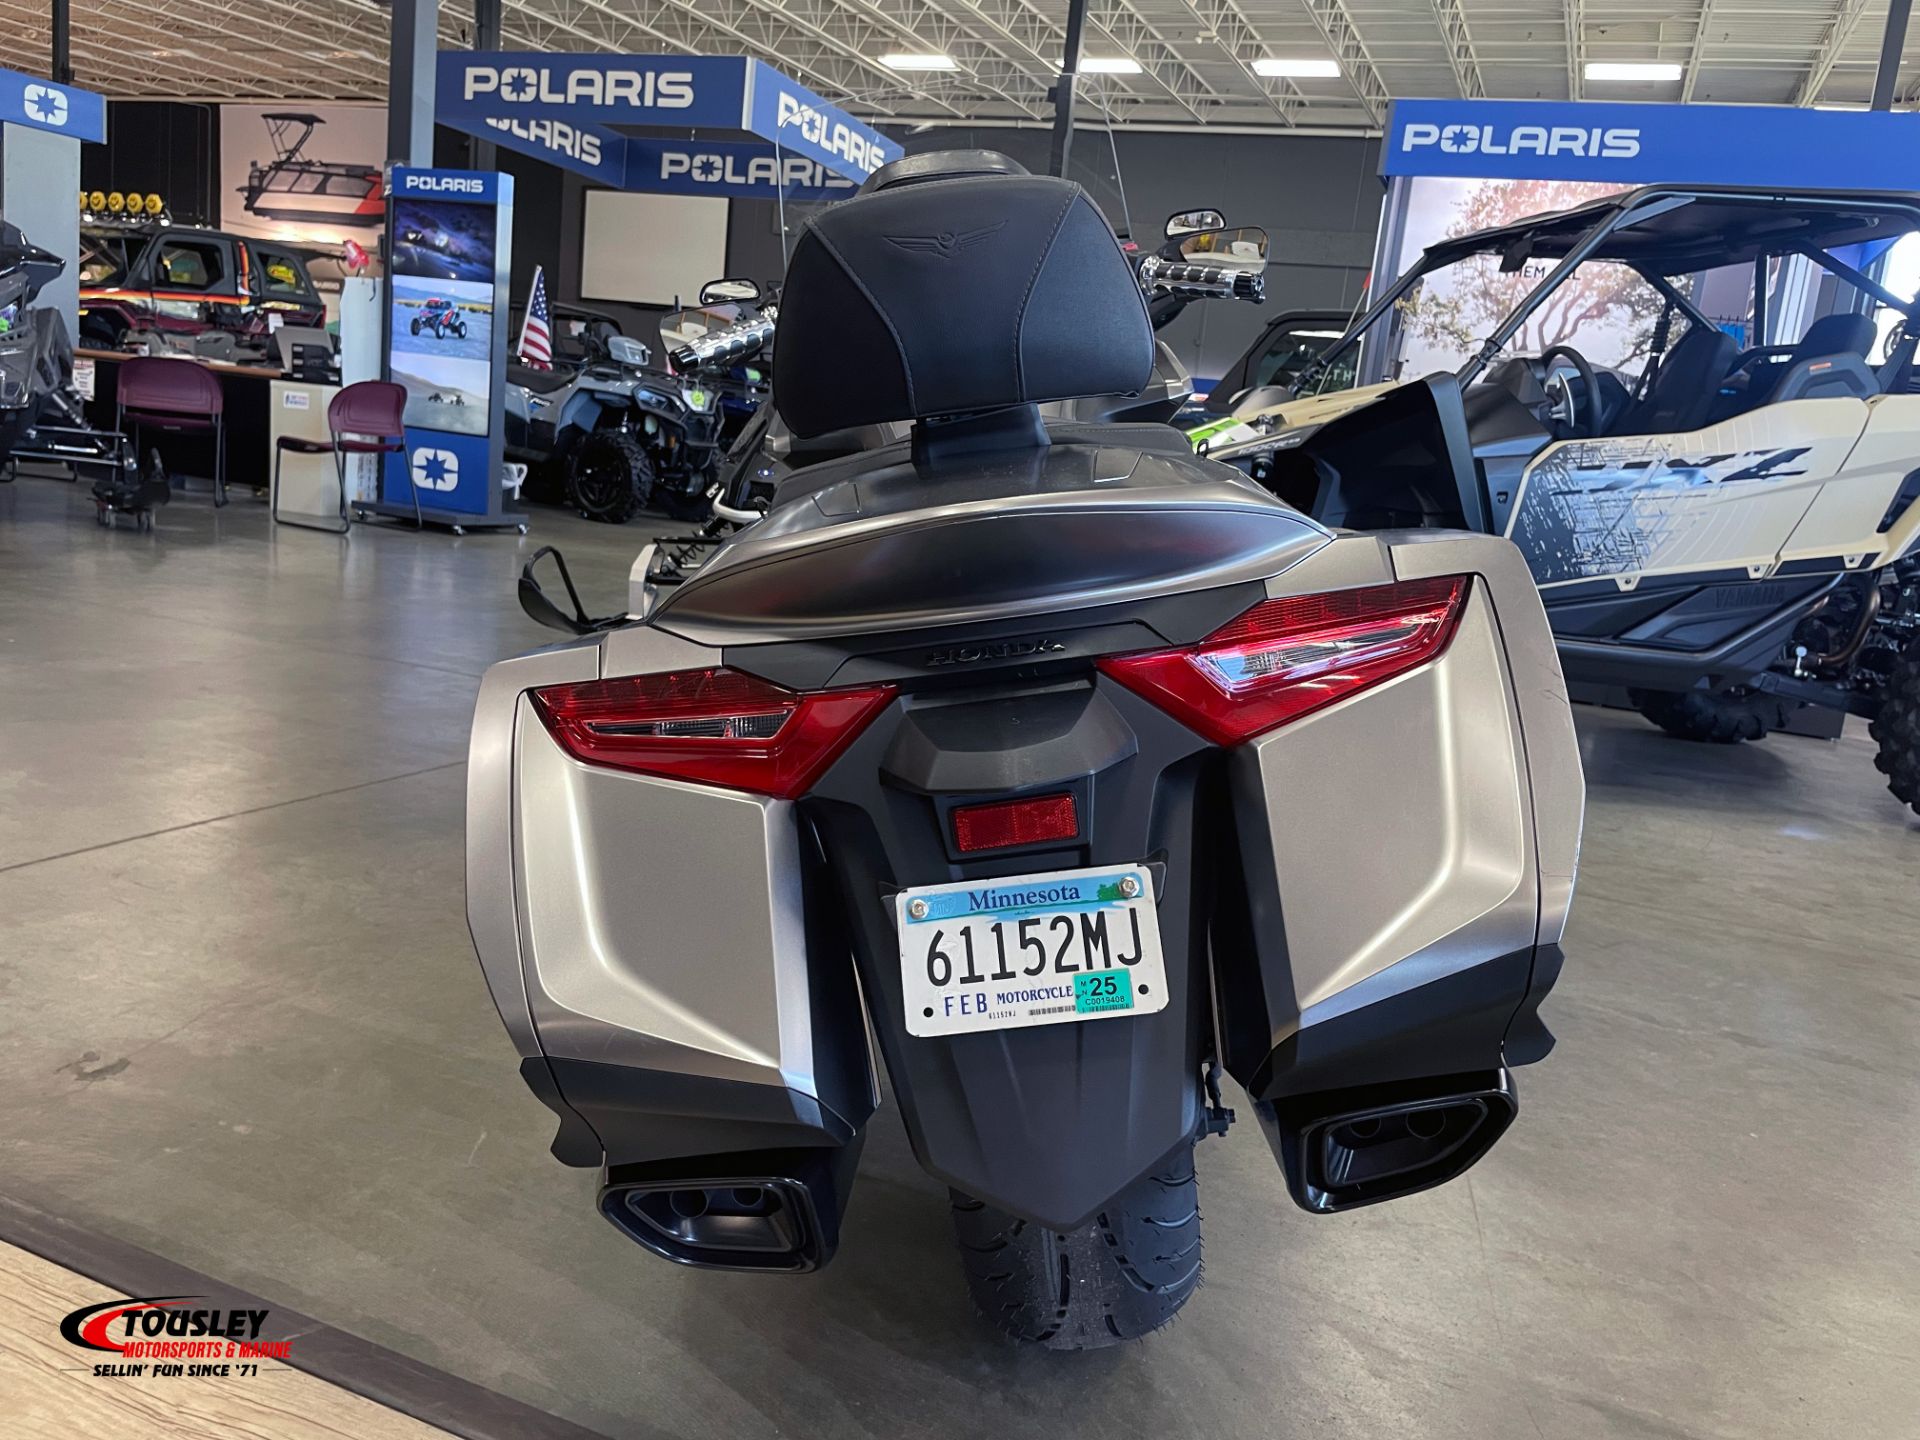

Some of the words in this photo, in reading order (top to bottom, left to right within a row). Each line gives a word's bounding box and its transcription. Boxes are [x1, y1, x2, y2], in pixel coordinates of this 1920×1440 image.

[464, 66, 694, 109] POLARIS
[486, 117, 602, 167] LARIS
[777, 90, 885, 175] POLARIS
[1402, 123, 1641, 158] POLARIS
[406, 175, 484, 193] POLARIS
[925, 639, 1067, 667] HONDA
[967, 884, 1082, 912] Minnesota
[926, 907, 1144, 988] 61152MJ
[944, 992, 988, 1018] FEB
[996, 985, 1074, 1006] MOTORCYCLE
[1089, 975, 1118, 997] 25
